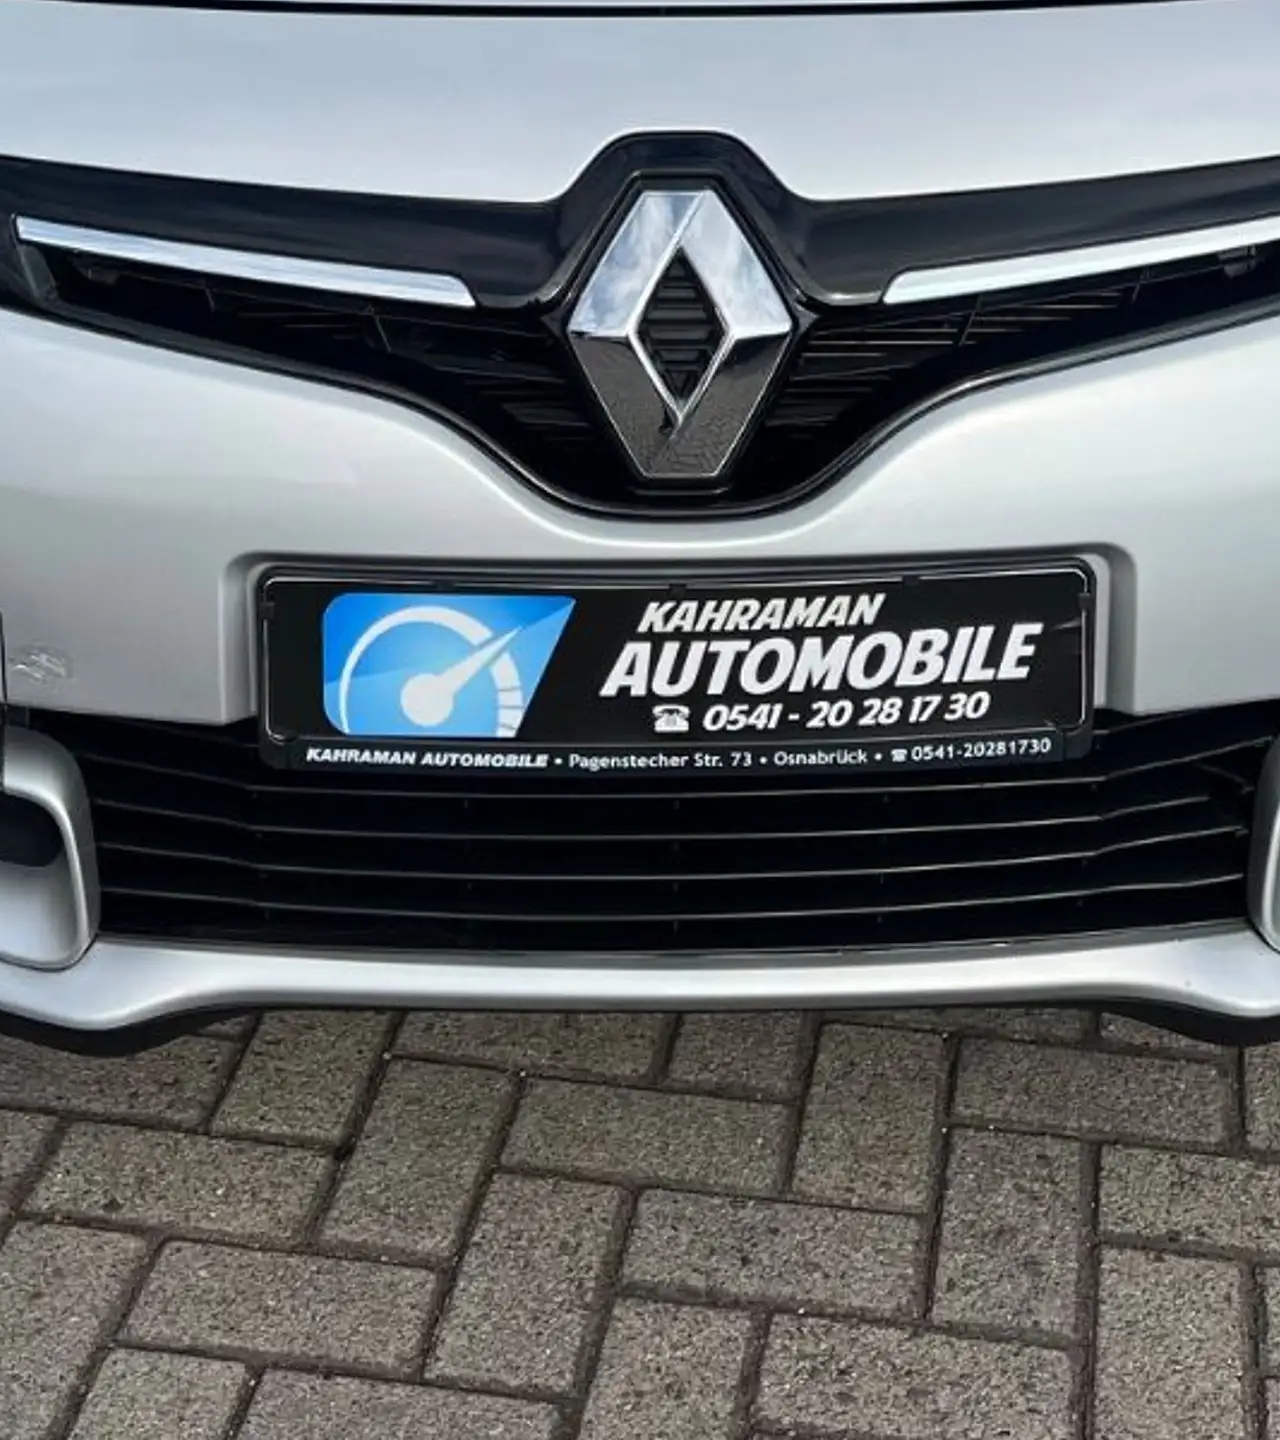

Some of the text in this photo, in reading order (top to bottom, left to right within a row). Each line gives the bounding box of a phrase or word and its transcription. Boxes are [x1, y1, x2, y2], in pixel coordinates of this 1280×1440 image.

[636, 592, 887, 633] KAHRAMAN
[598, 622, 1045, 698] AUTOMOBILE
[702, 702, 782, 731] 0541
[805, 699, 854, 728] 20
[858, 697, 904, 726] 28
[908, 694, 937, 723] 17
[943, 691, 991, 720] 30
[306, 736, 1052, 772] KAHRAMAN AUTOMOBILE Pagenstecher Str. 73 Osnabrück 0541-20281730
